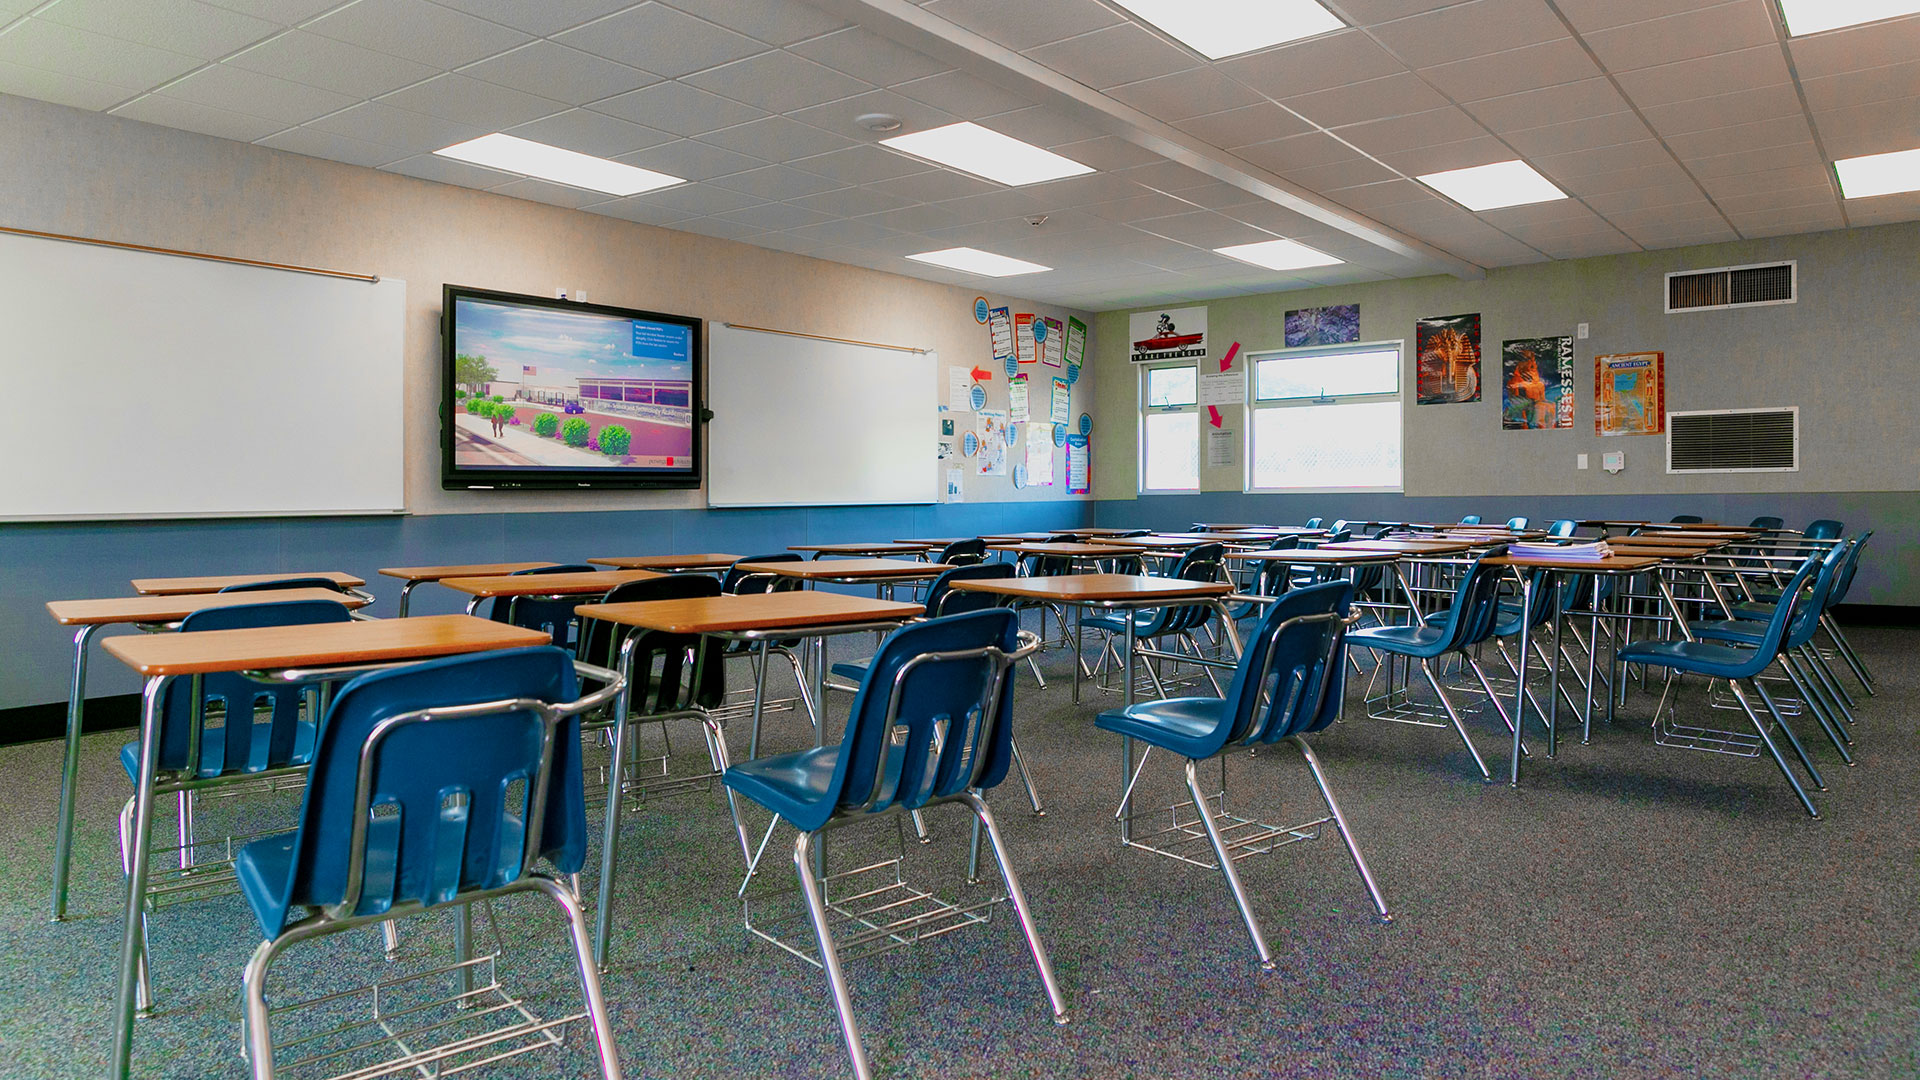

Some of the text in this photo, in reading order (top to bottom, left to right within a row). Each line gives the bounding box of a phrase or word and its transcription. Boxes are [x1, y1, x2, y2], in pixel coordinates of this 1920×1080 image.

[1133, 353, 1160, 361] SHARE
[1182, 349, 1204, 357] ROAD
[1561, 337, 1573, 413] RAMESSES
